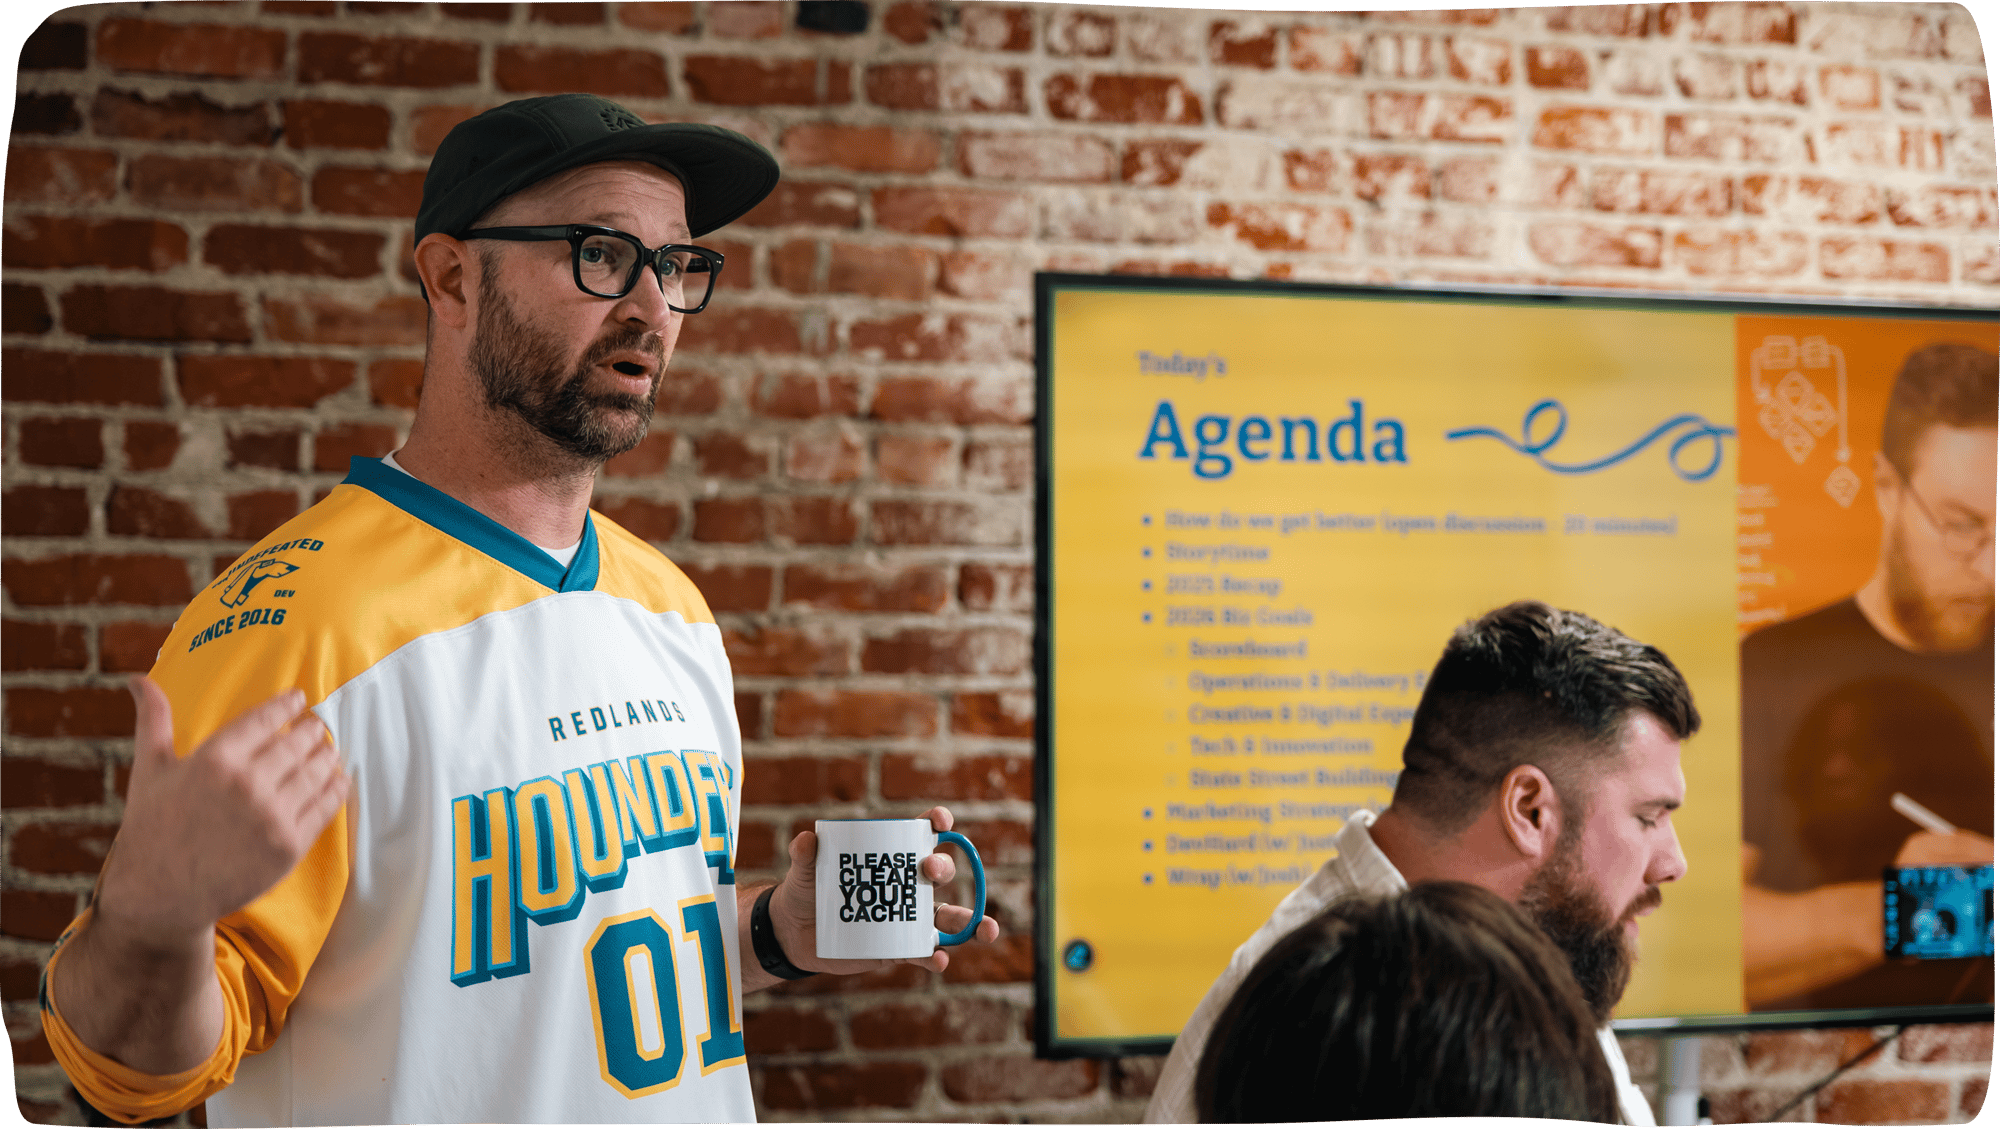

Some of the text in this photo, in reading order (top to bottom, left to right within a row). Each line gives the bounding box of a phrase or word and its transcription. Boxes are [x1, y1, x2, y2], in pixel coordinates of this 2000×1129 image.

[1136, 350, 1228, 380] Today's
[1137, 397, 1410, 481] Agenda
[1165, 541, 1271, 565] Storytime
[273, 589, 296, 598] DEV
[1220, 575, 1282, 598] Recap
[1256, 606, 1314, 627] Goals
[189, 608, 287, 653] SINCE 2016
[1189, 638, 1308, 659] Scoreboard
[1189, 671, 1304, 696] Operations
[1326, 671, 1410, 693] Delivery
[547, 698, 686, 743] REDLANDS
[1189, 704, 1275, 724] Creative
[1298, 704, 1364, 728] Digital
[1190, 736, 1238, 756] Tech
[1261, 738, 1373, 756] Innovation
[1189, 768, 1243, 788] State
[1247, 768, 1310, 788] Street
[1166, 801, 1273, 825] Marketing
[839, 853, 917, 869] PLEASE
[839, 865, 917, 886] CLEAR
[839, 883, 917, 906] YOUR
[839, 904, 917, 922] CACHE
[582, 892, 748, 1100] 01
